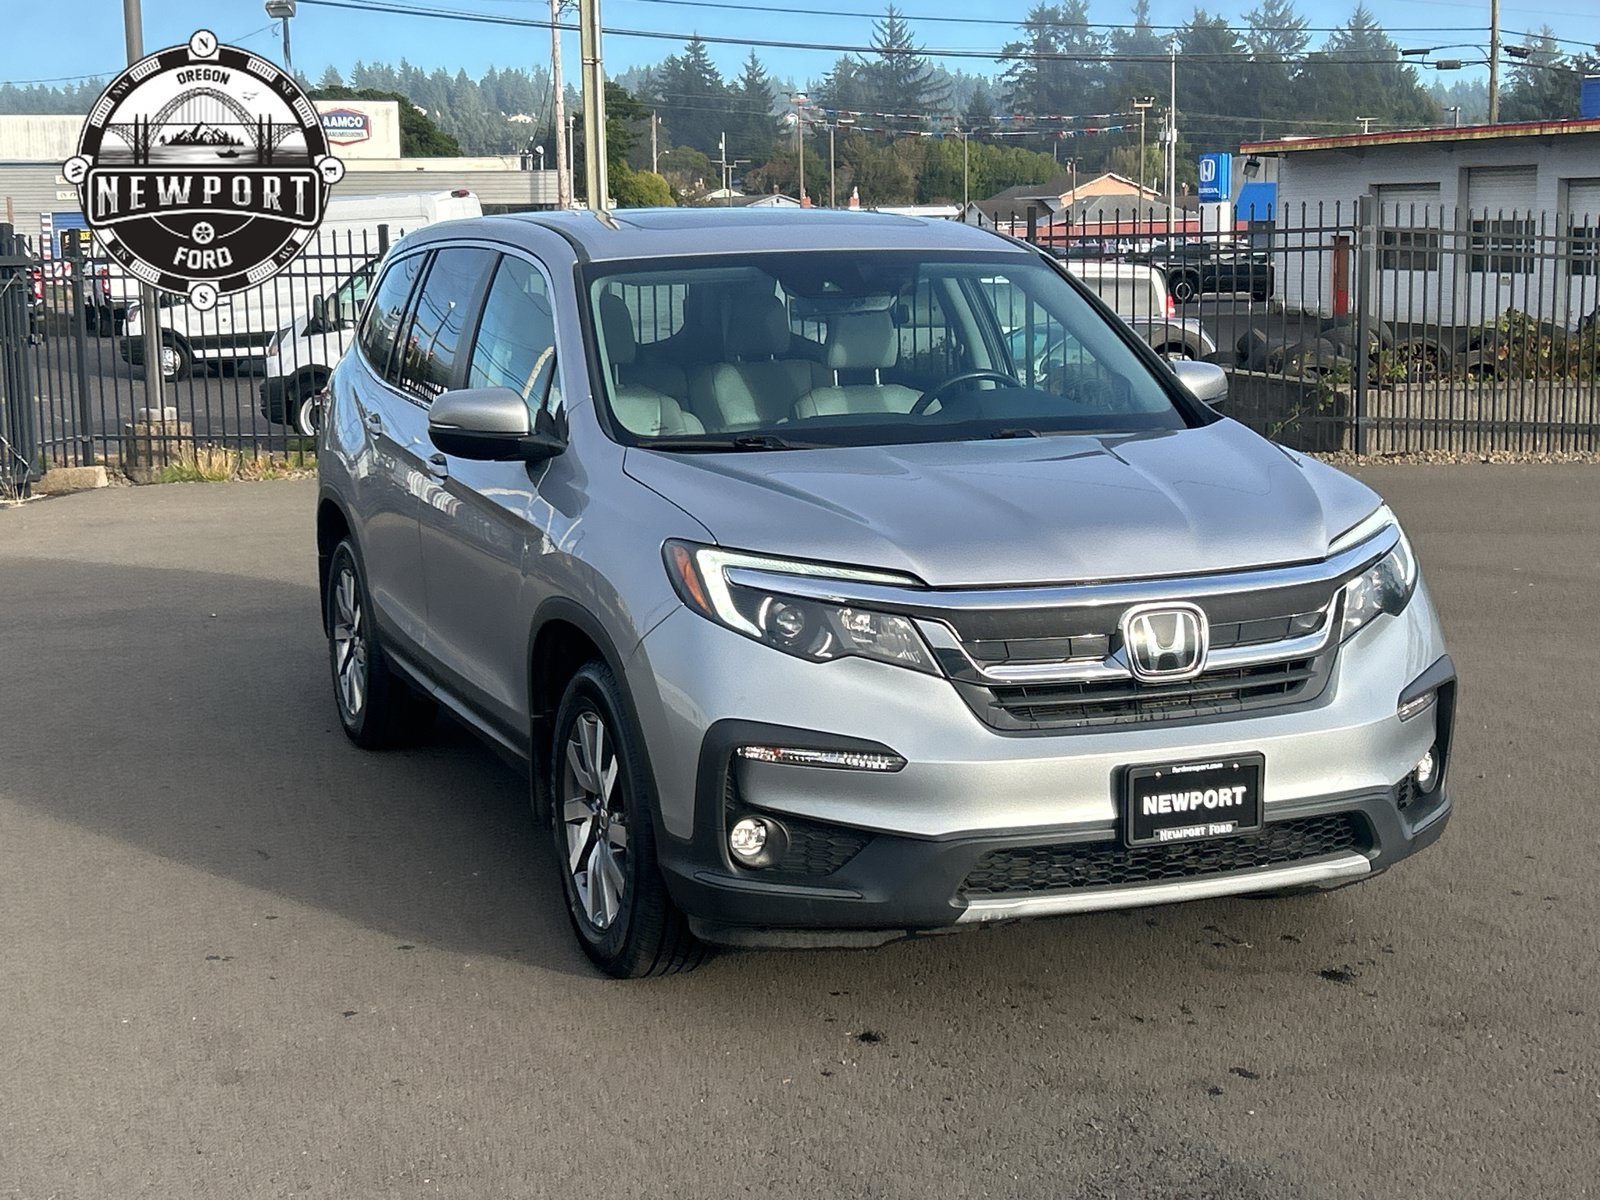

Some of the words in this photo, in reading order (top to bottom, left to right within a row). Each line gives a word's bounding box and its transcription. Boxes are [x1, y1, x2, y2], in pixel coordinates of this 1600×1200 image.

[323, 116, 363, 127] AAMCO
[1143, 786, 1246, 815] NEWPORT
[1209, 824, 1232, 835] FORD
